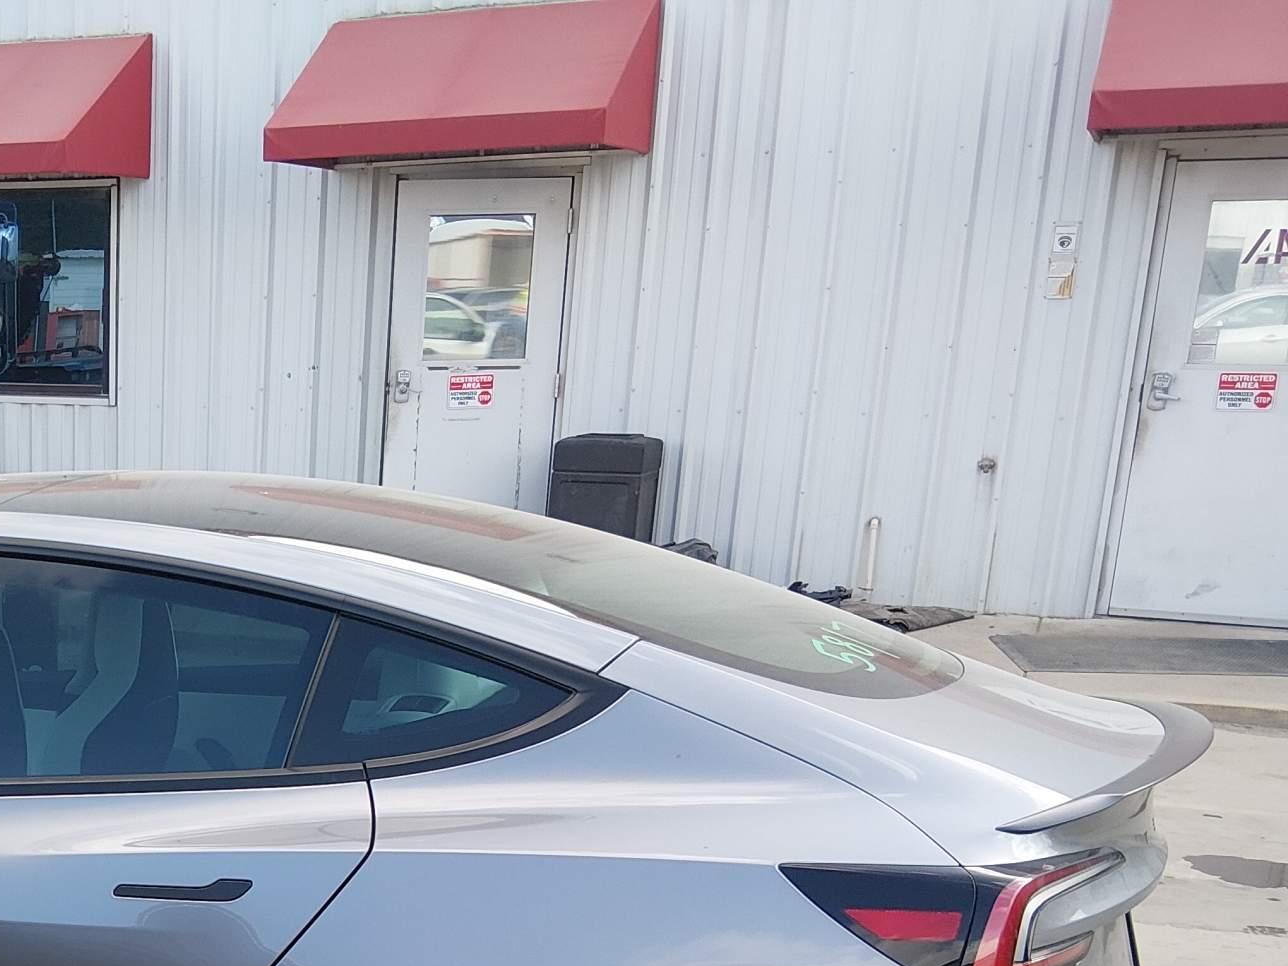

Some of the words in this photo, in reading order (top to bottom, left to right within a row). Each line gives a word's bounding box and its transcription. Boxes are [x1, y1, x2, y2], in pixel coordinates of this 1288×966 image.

[1222, 374, 1276, 382] RESTRICTED
[1234, 381, 1259, 389] AREA
[1256, 396, 1272, 404] STOP
